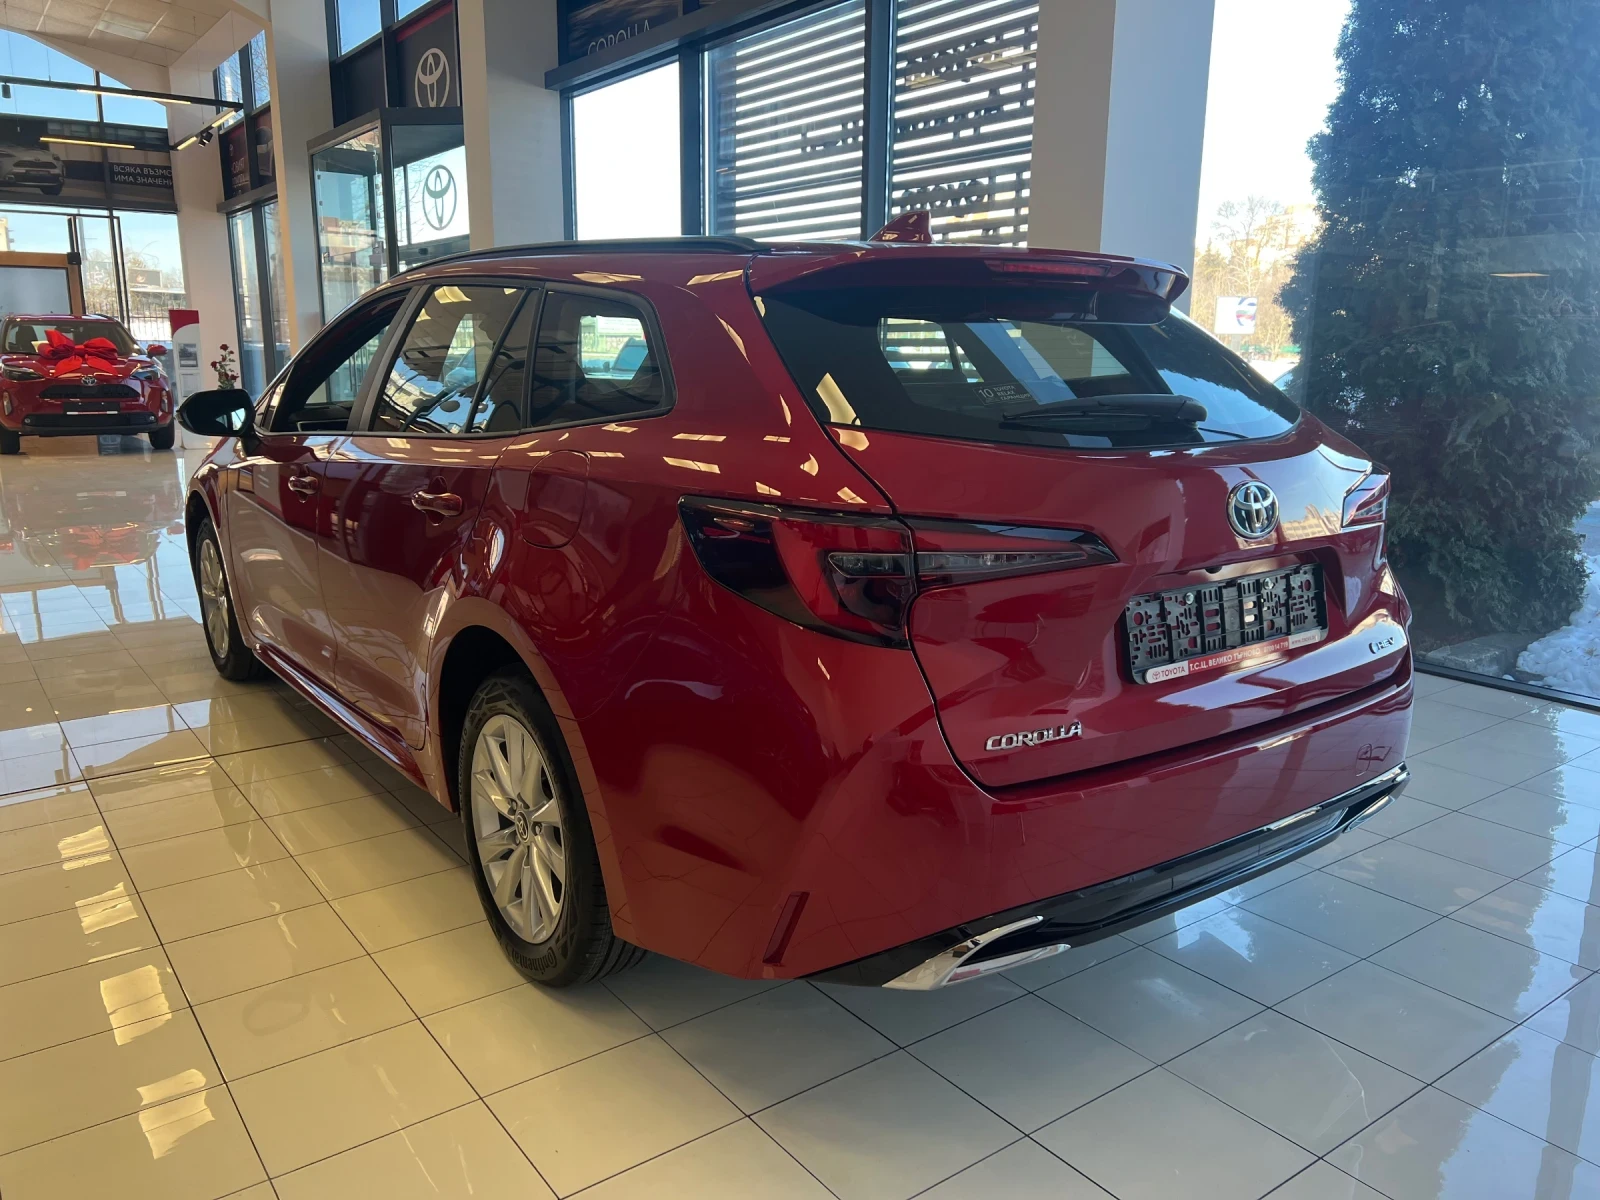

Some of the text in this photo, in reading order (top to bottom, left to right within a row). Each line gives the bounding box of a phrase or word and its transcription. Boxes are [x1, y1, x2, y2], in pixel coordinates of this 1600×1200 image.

[113, 164, 141, 174] ВСЯКА
[114, 174, 135, 183] ИМА
[978, 388, 994, 398] 10
[1208, 655, 1233, 667] ВЕЛИКО
[1233, 647, 1261, 660] ТЪРНОВО
[1161, 666, 1186, 678] TOYOTA
[985, 721, 1083, 751] COROLLA
[511, 946, 558, 976] Continental
